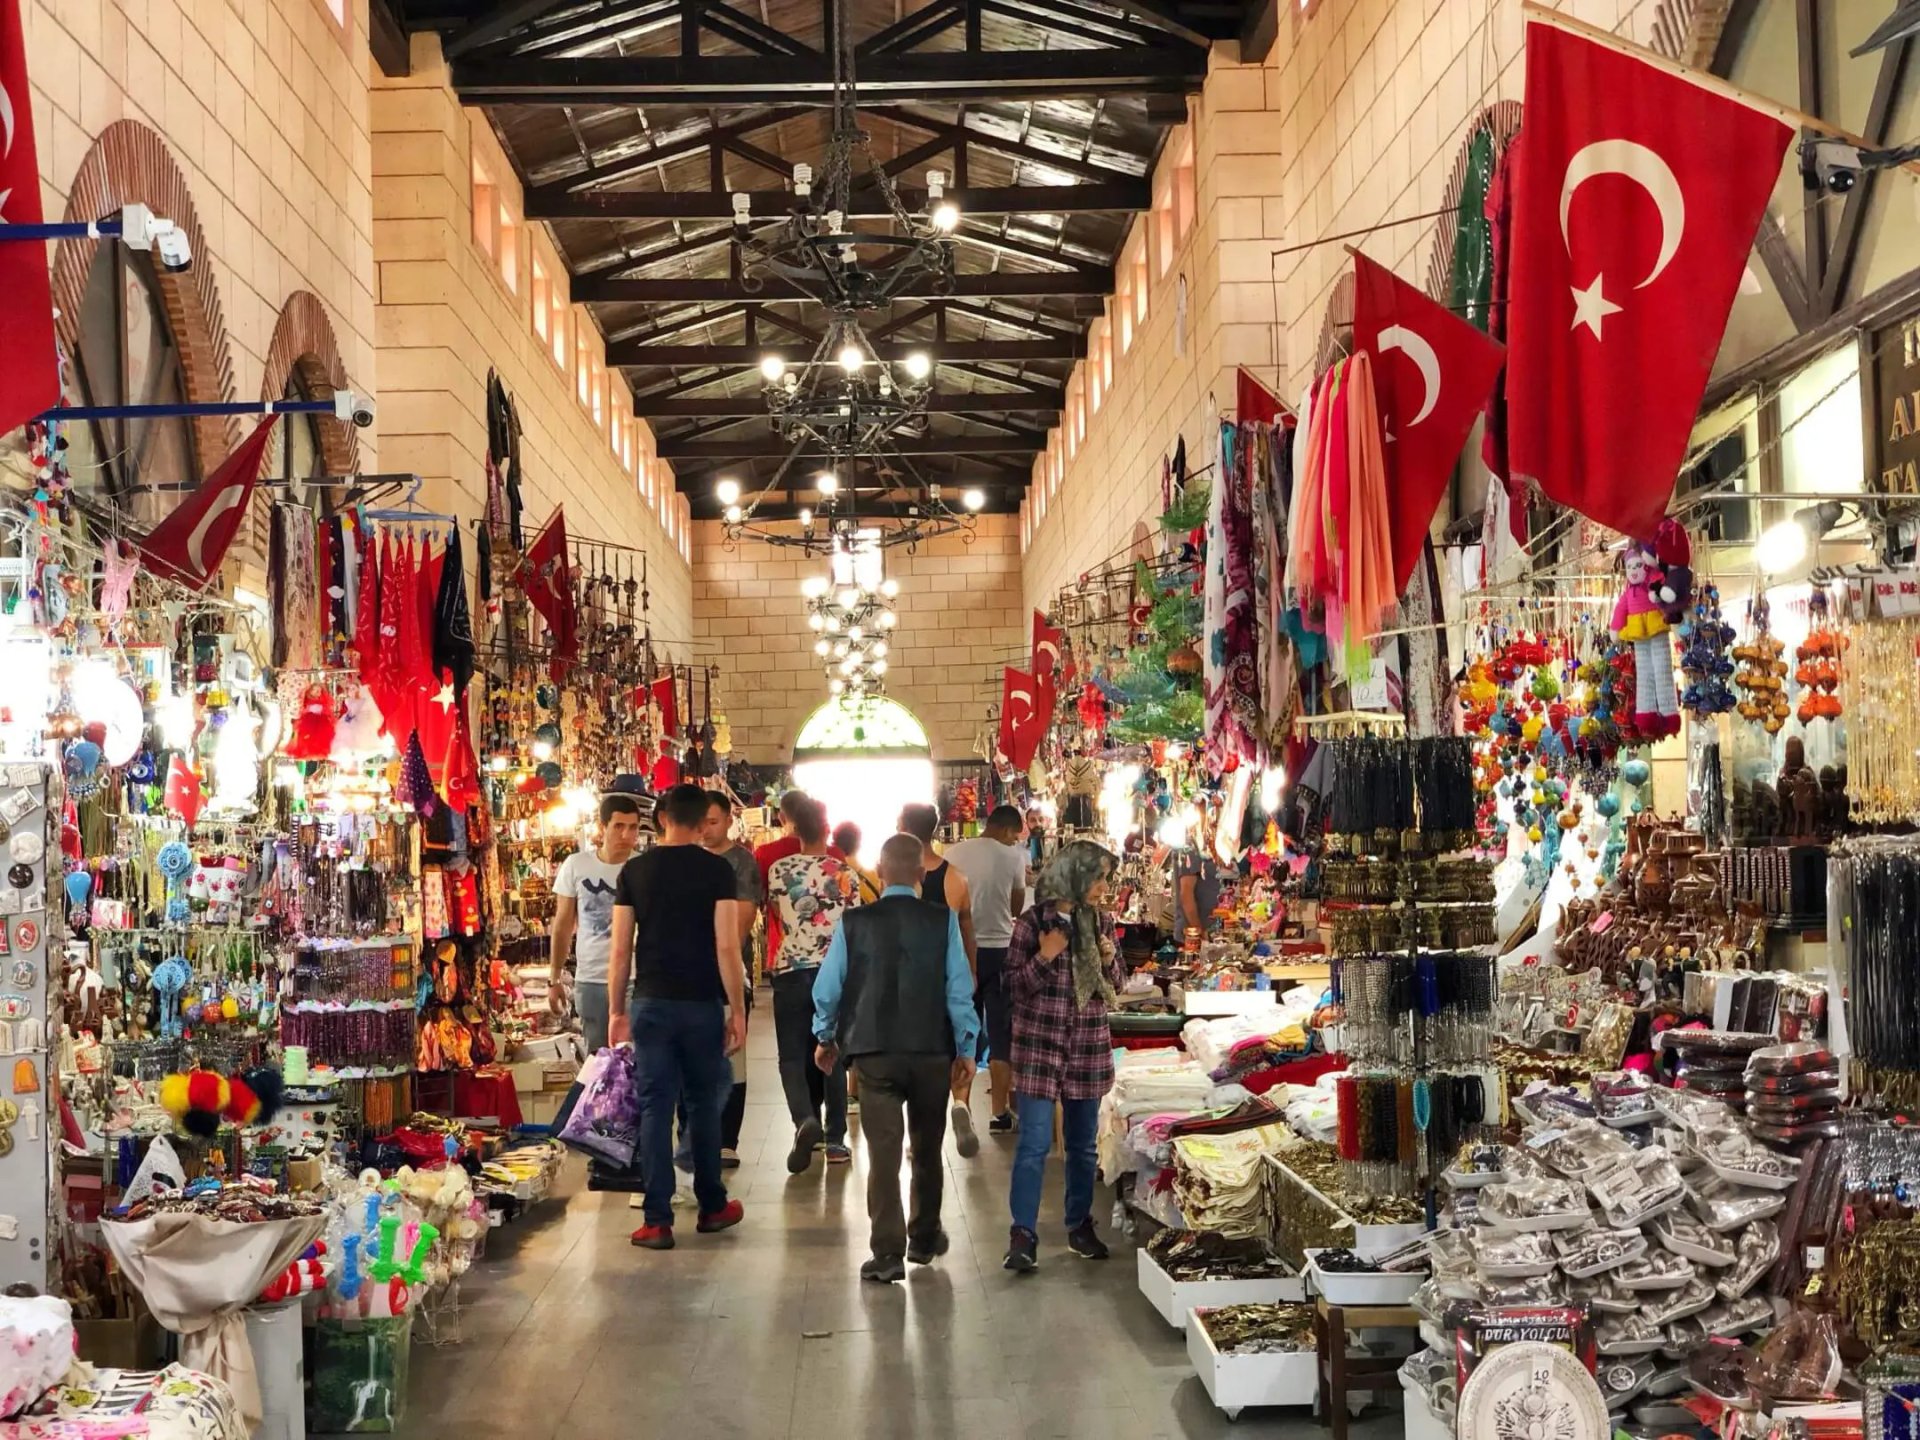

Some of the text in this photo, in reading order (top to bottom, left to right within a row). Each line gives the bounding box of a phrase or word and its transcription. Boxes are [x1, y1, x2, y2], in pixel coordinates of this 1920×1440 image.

[1485, 1327, 1566, 1341] DUR YOLCU
[1534, 1369, 1549, 1381] 10
